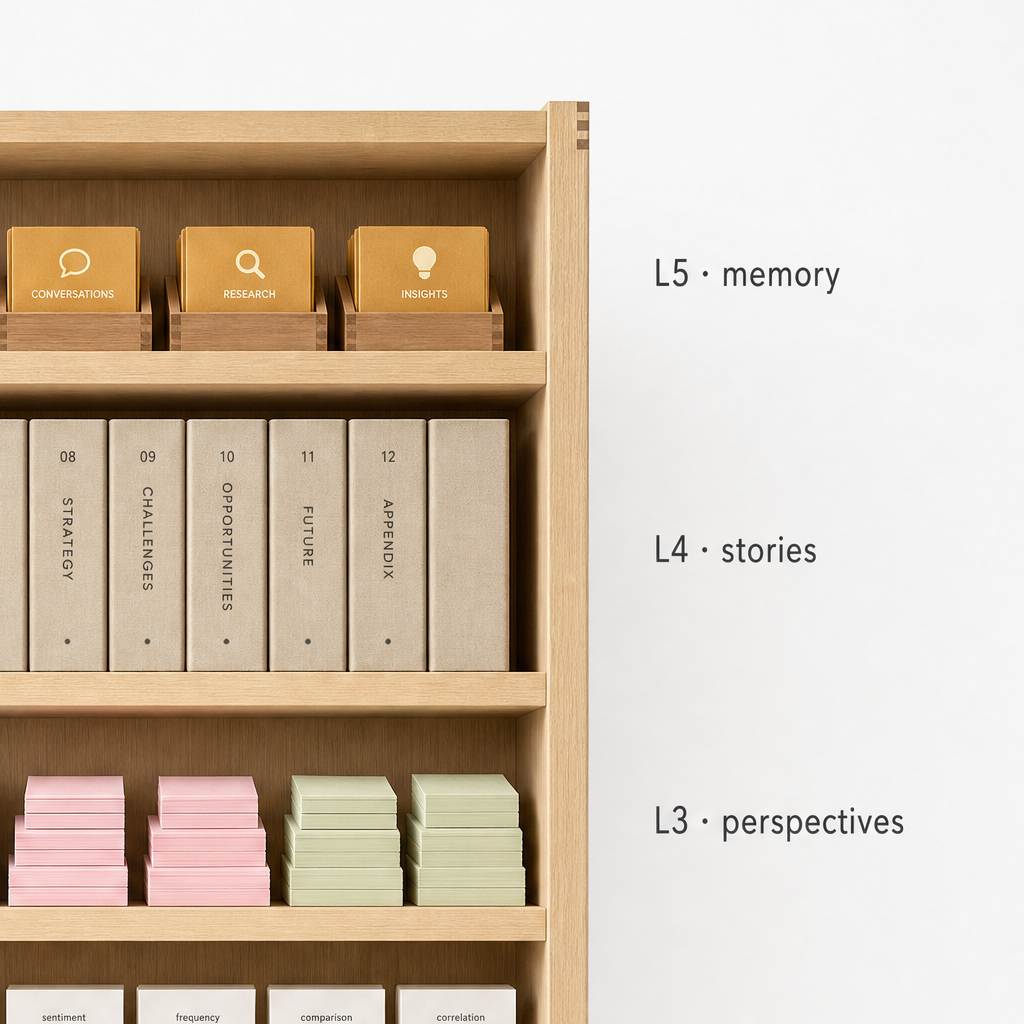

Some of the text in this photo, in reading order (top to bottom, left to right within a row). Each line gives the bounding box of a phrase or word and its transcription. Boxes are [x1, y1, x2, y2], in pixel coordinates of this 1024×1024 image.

[31, 289, 114, 299] CONVERSATIONS
[223, 289, 276, 299] RESEARCH
[401, 289, 448, 299] INSIGHTS
[59, 450, 76, 463] 08
[139, 450, 156, 463] 09
[219, 450, 235, 463] 10
[301, 450, 314, 463] 11
[381, 450, 396, 463] 12
[62, 497, 74, 581] STRATEGY
[142, 486, 154, 591] CHALLENGES
[302, 506, 314, 567] FUTURE
[383, 498, 394, 579] APPENDIX
[221, 482, 233, 611] OPPORTUNITIES
[42, 1012, 86, 1022] sentiment
[175, 1012, 221, 1024] frequency
[300, 1012, 353, 1024] comparison
[436, 1012, 486, 1022] correlation
